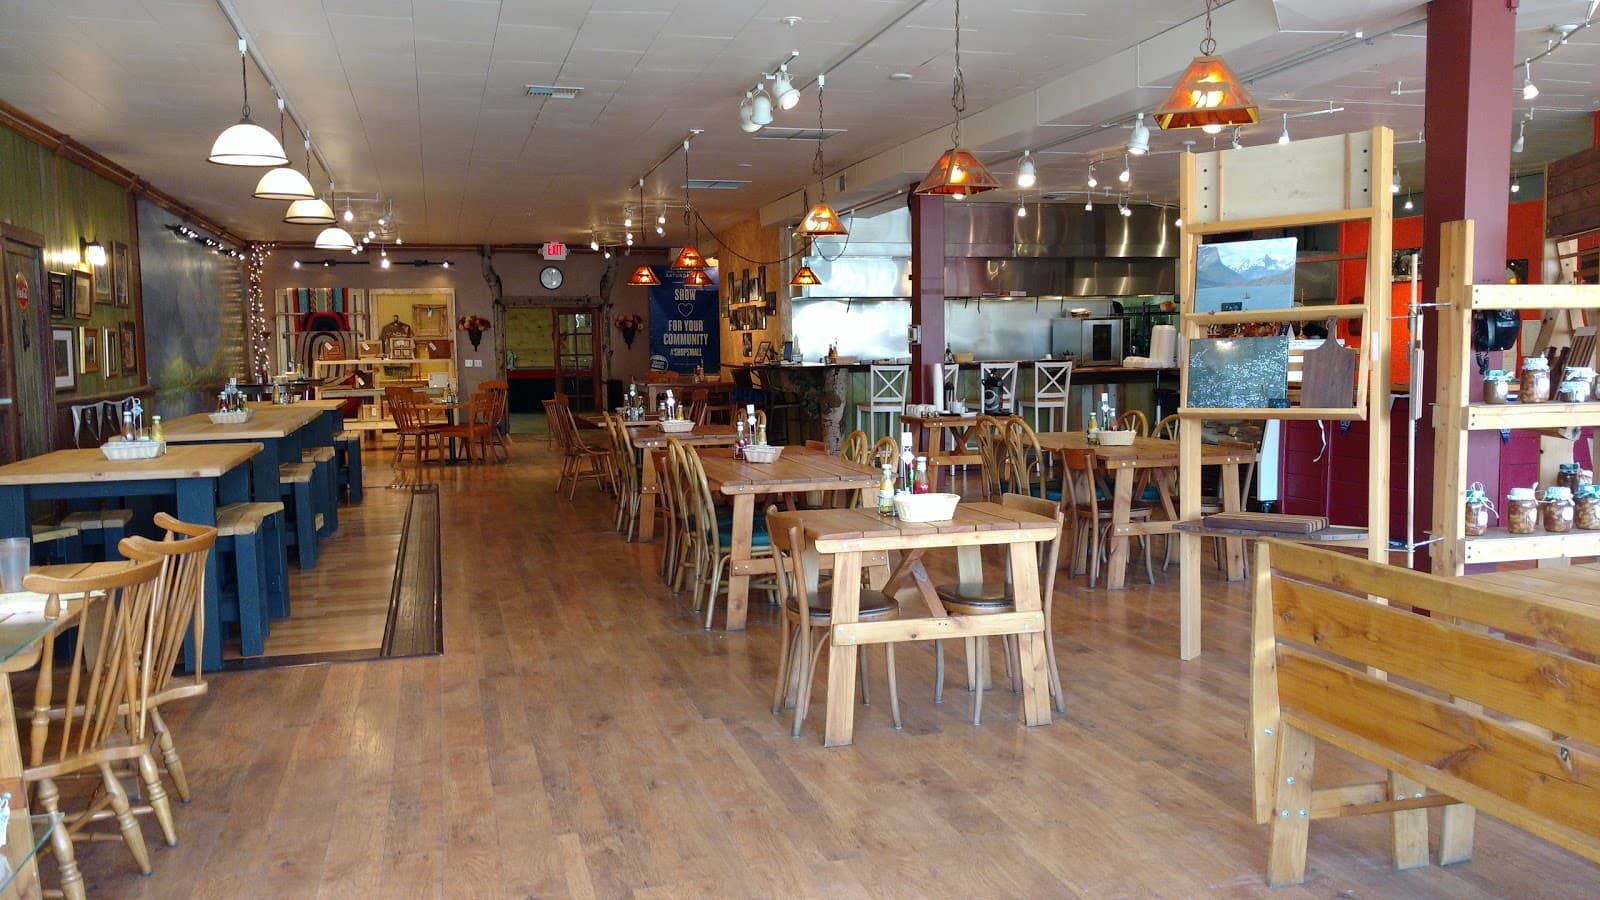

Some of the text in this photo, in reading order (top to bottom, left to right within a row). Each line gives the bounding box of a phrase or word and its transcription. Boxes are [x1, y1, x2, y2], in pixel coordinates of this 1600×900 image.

[547, 244, 562, 256] EXIT
[674, 288, 697, 301] SHOW
[668, 319, 704, 332] FOR YOUR
[663, 333, 709, 345] COMMUNITY
